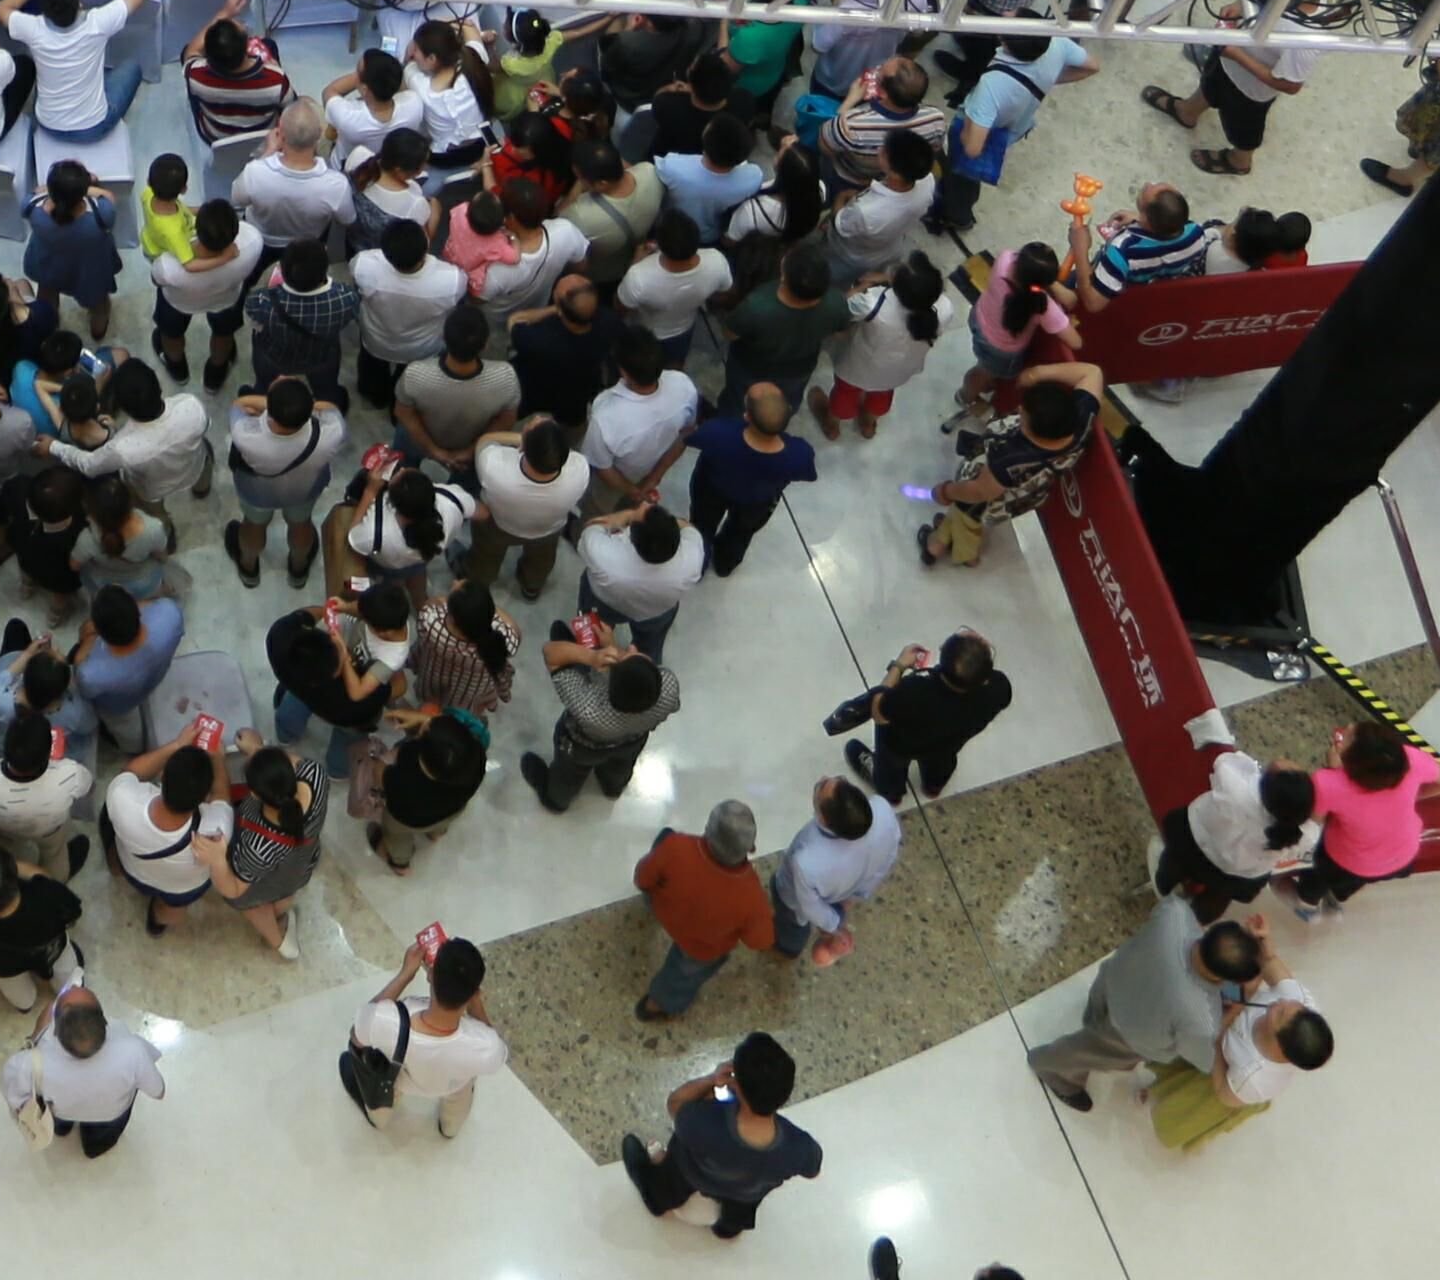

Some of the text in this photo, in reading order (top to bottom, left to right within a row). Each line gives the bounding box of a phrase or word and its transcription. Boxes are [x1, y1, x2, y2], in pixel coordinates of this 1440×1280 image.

[1198, 309, 1324, 333] 万达广
[1081, 516, 1165, 709] 万达广场
